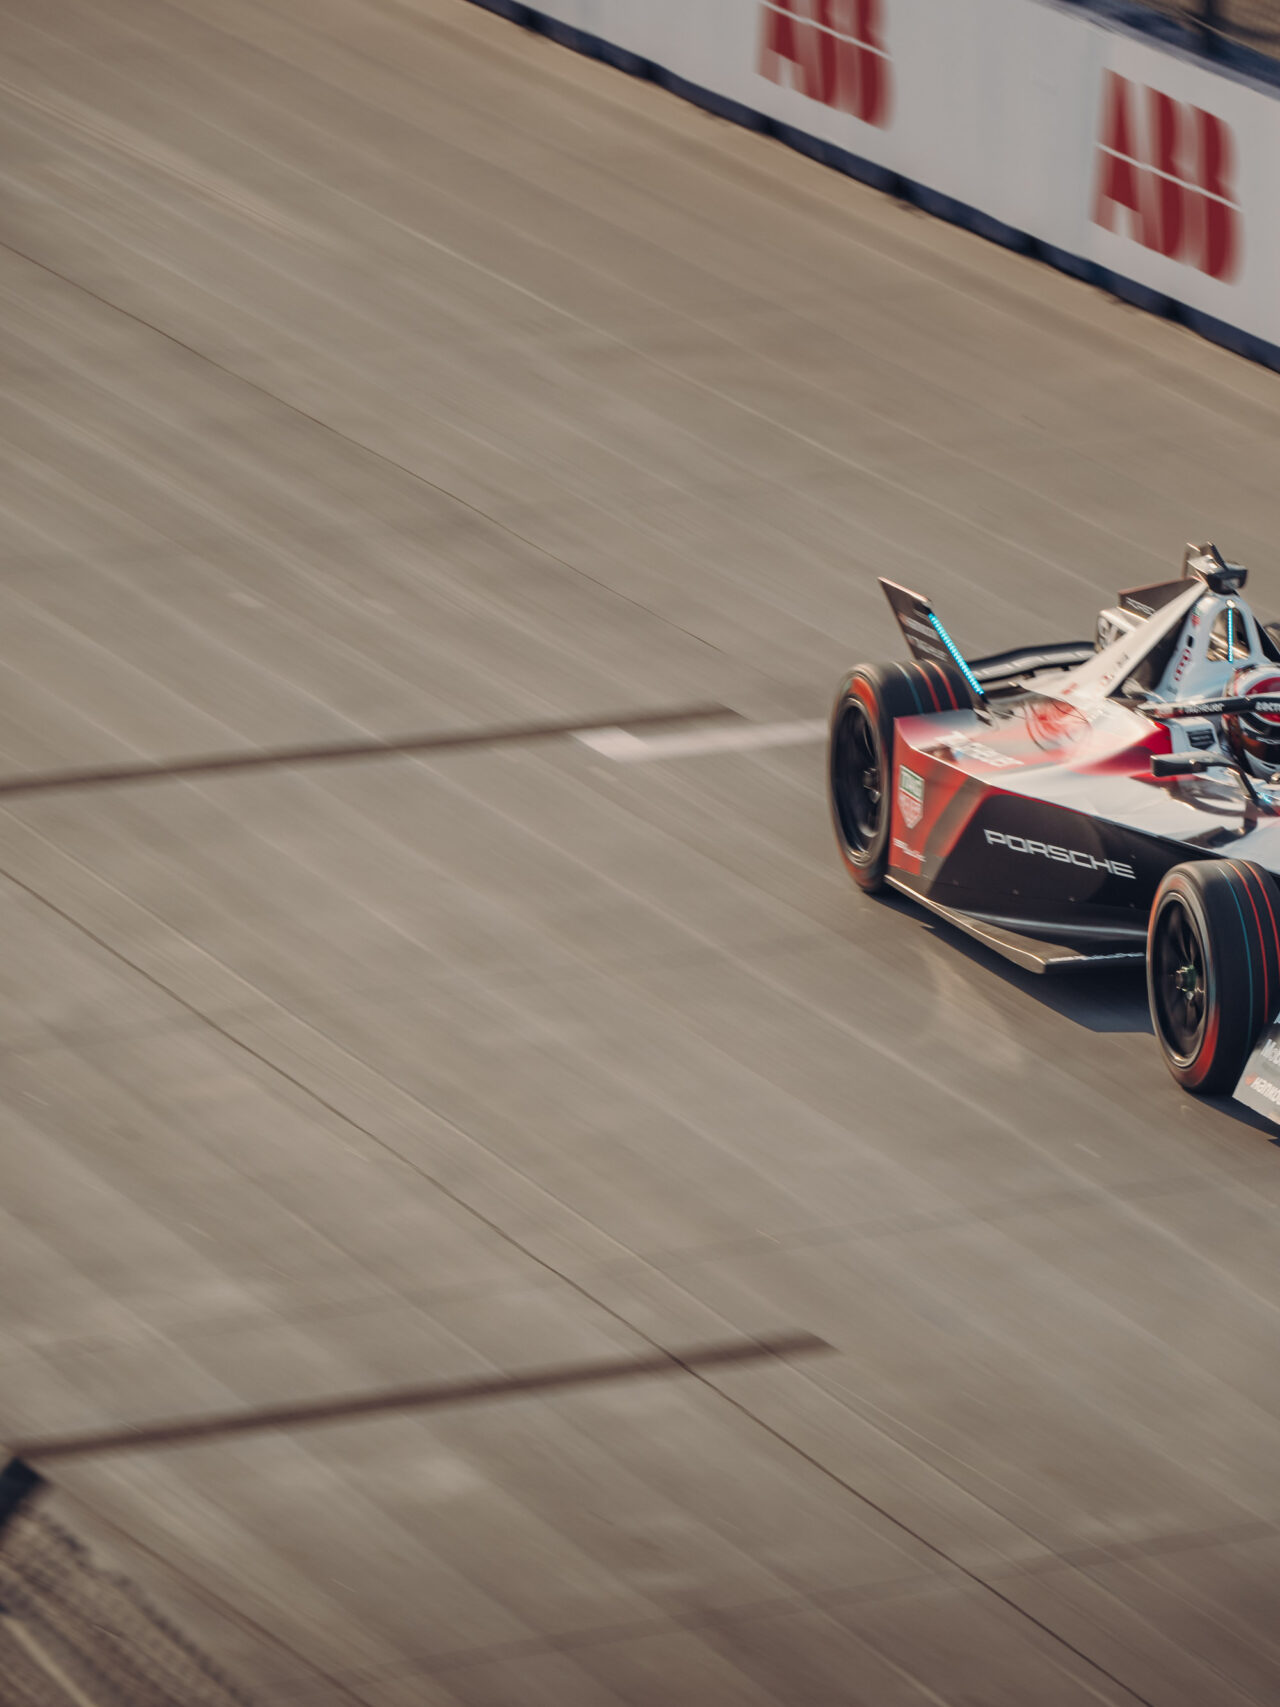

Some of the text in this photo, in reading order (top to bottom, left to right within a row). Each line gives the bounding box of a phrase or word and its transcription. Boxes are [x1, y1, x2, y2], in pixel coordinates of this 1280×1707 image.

[756, 0, 893, 131] ABB
[1091, 68, 1242, 285] ABB
[983, 828, 1137, 880] PORSCHE
